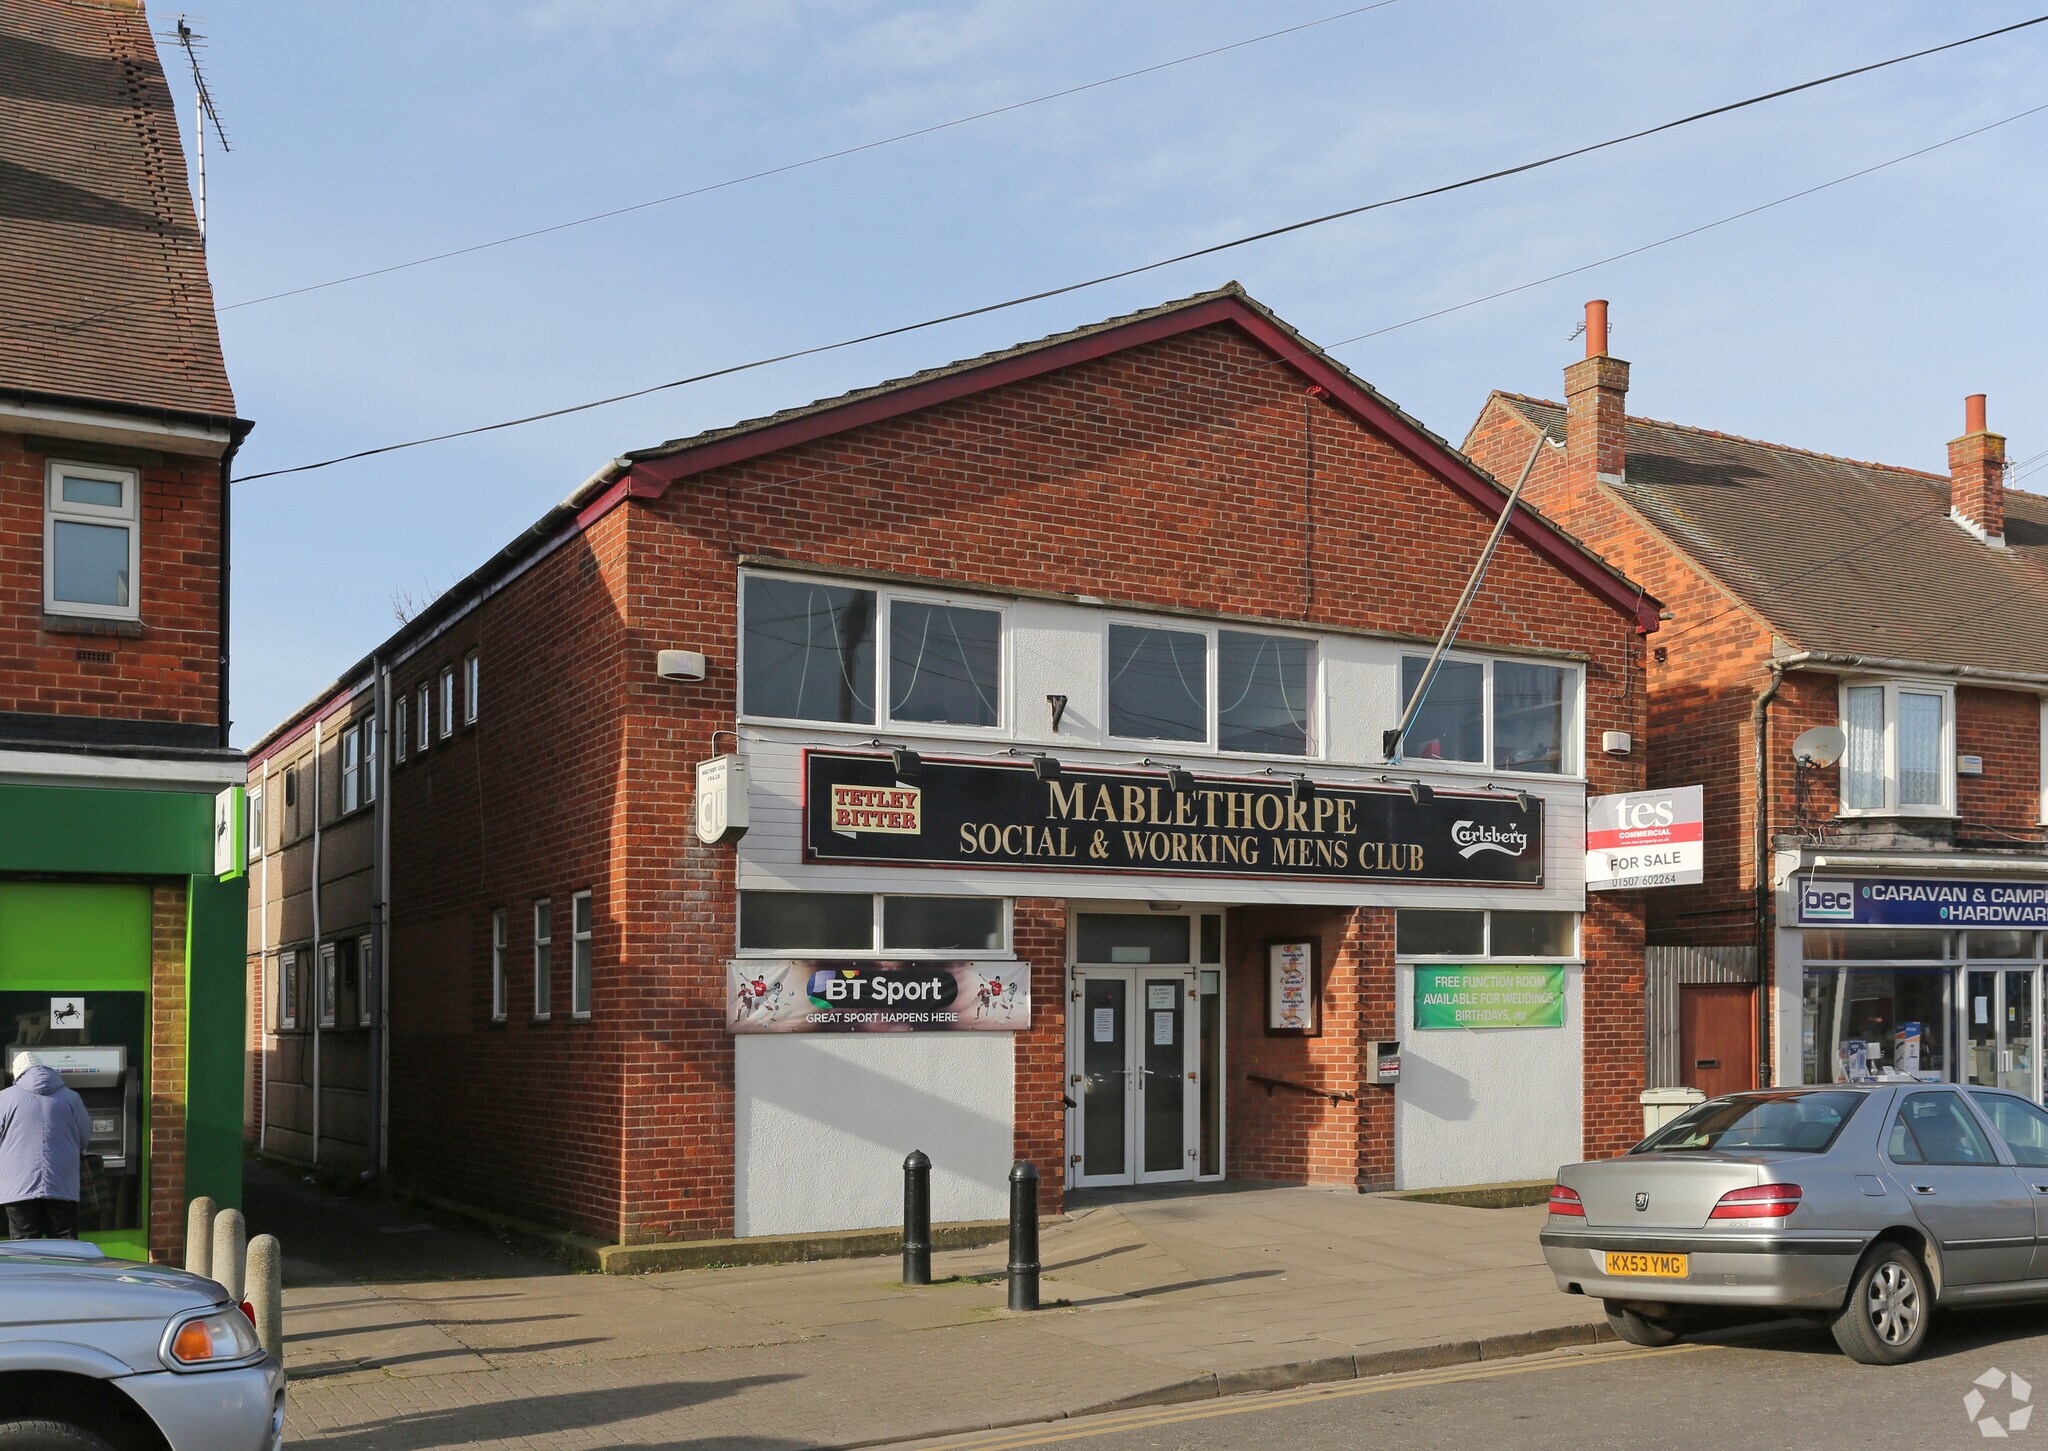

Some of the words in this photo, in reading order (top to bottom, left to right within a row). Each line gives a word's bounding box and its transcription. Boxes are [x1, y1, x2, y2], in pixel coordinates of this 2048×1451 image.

[835, 788, 918, 809] TETLEY
[1046, 780, 1358, 835] MABLETHORPE
[836, 808, 917, 829] BITTER
[1614, 797, 1674, 831] tes
[1451, 820, 1528, 855] Carlsberg
[1619, 828, 1672, 839] COMMERCIAL
[960, 822, 1077, 857] SOCIAL
[1089, 829, 1109, 859] &
[1122, 830, 1260, 865] WORKING
[1272, 837, 1348, 868] MENS
[1359, 842, 1424, 871] CLUB
[1610, 856, 1639, 871] FOR
[1643, 851, 1681, 868] SALE
[1612, 876, 1639, 888] 01507
[1642, 874, 1676, 886] 602264
[1805, 885, 1851, 909] bec
[1872, 885, 1967, 902] CARAVAN
[1973, 888, 1986, 903] &
[1950, 906, 2048, 921] HARDWAR
[825, 979, 867, 1000] BT
[871, 976, 942, 1005] Sport
[1435, 976, 1460, 988] FREE
[1462, 976, 1513, 988] FUNCTION
[1516, 975, 1546, 988] ROOM
[1423, 993, 1477, 1005] AVAILABLE
[1480, 993, 1500, 1005] FOR
[1503, 992, 1556, 1006] WEDDINGS,
[806, 1013, 841, 1023] GREAT
[844, 1013, 879, 1023] SPORT
[881, 1012, 929, 1023] HAPPENS
[931, 1012, 958, 1022] HERE
[1455, 1009, 1511, 1022] BIRTHDAYS,
[1612, 1255, 1647, 1272] KX53
[1651, 1256, 1680, 1273] YMG
